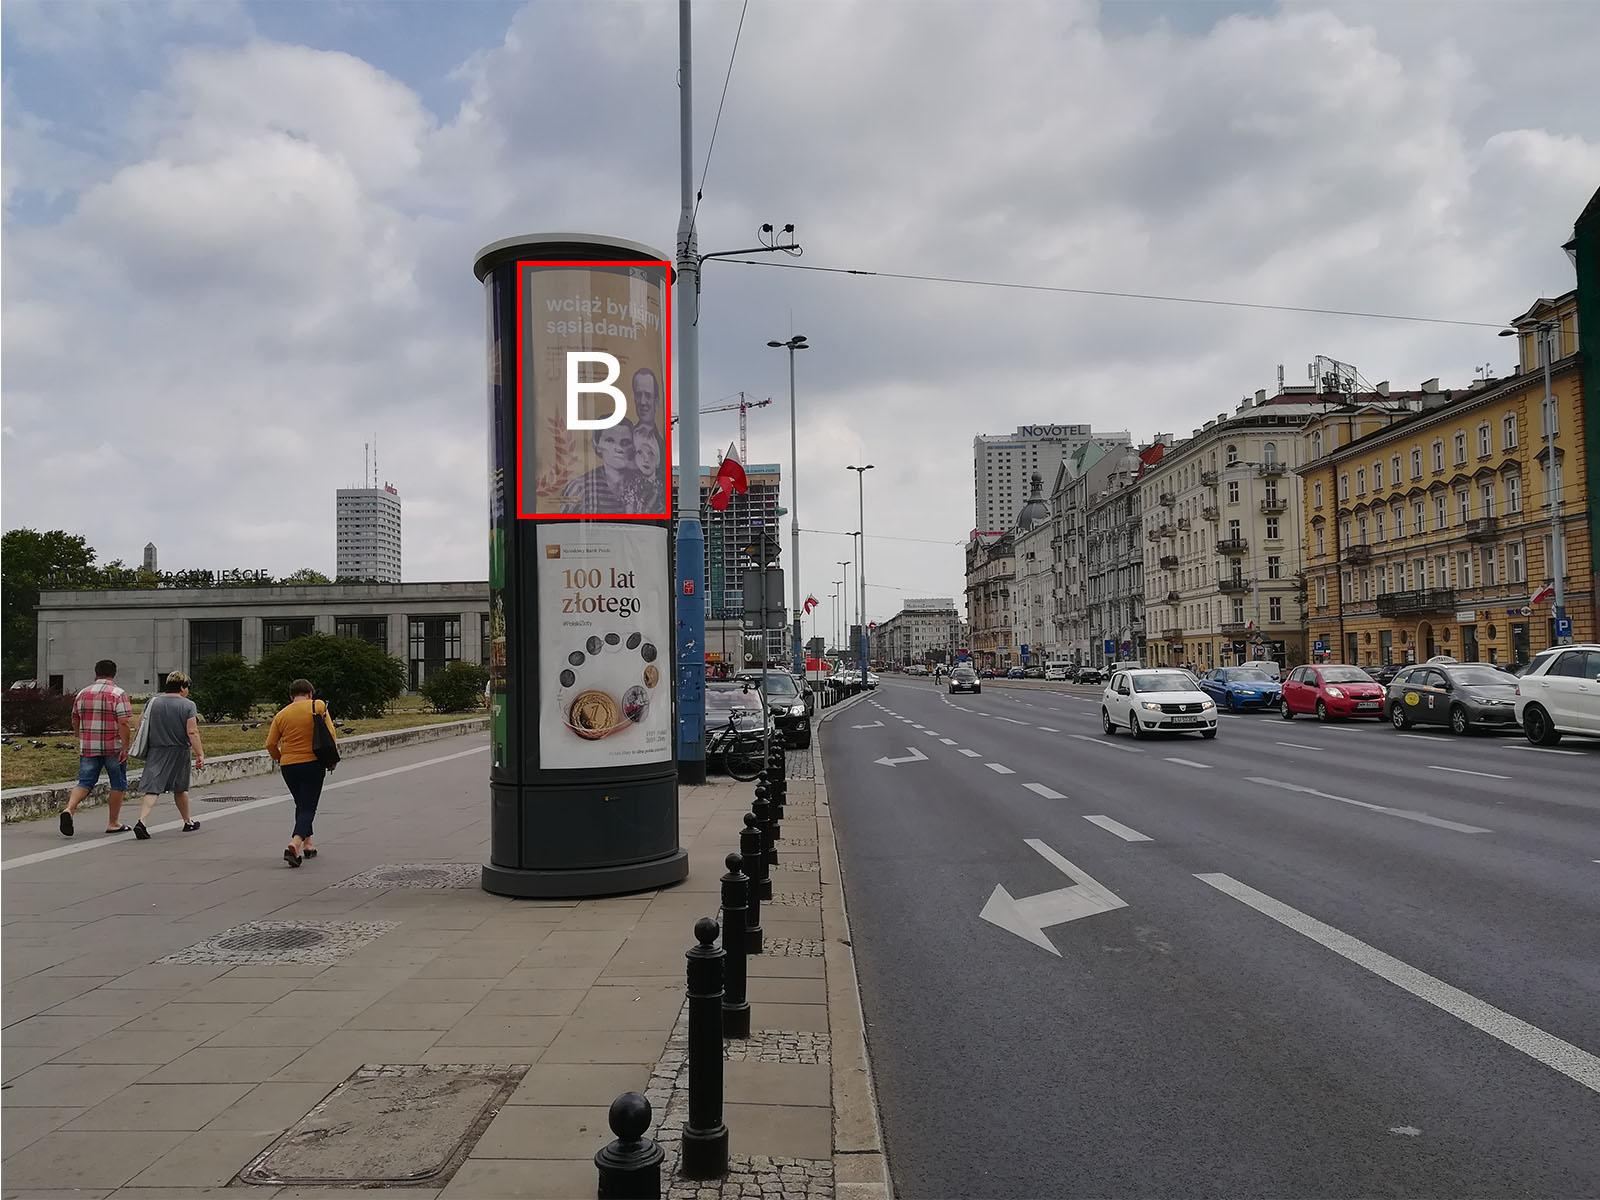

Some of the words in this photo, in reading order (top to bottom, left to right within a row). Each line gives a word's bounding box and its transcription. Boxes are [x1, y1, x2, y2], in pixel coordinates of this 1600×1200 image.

[546, 295, 602, 316] wciąż
[546, 316, 637, 340] sąsiadami
[1023, 424, 1087, 437] NOVOTEL
[154, 567, 269, 583] RÓMIEŚCIE
[562, 568, 602, 589] 100
[609, 567, 636, 589] lat
[562, 592, 641, 618] złotego
[1558, 620, 1569, 631] P
[1315, 641, 1323, 650] P
